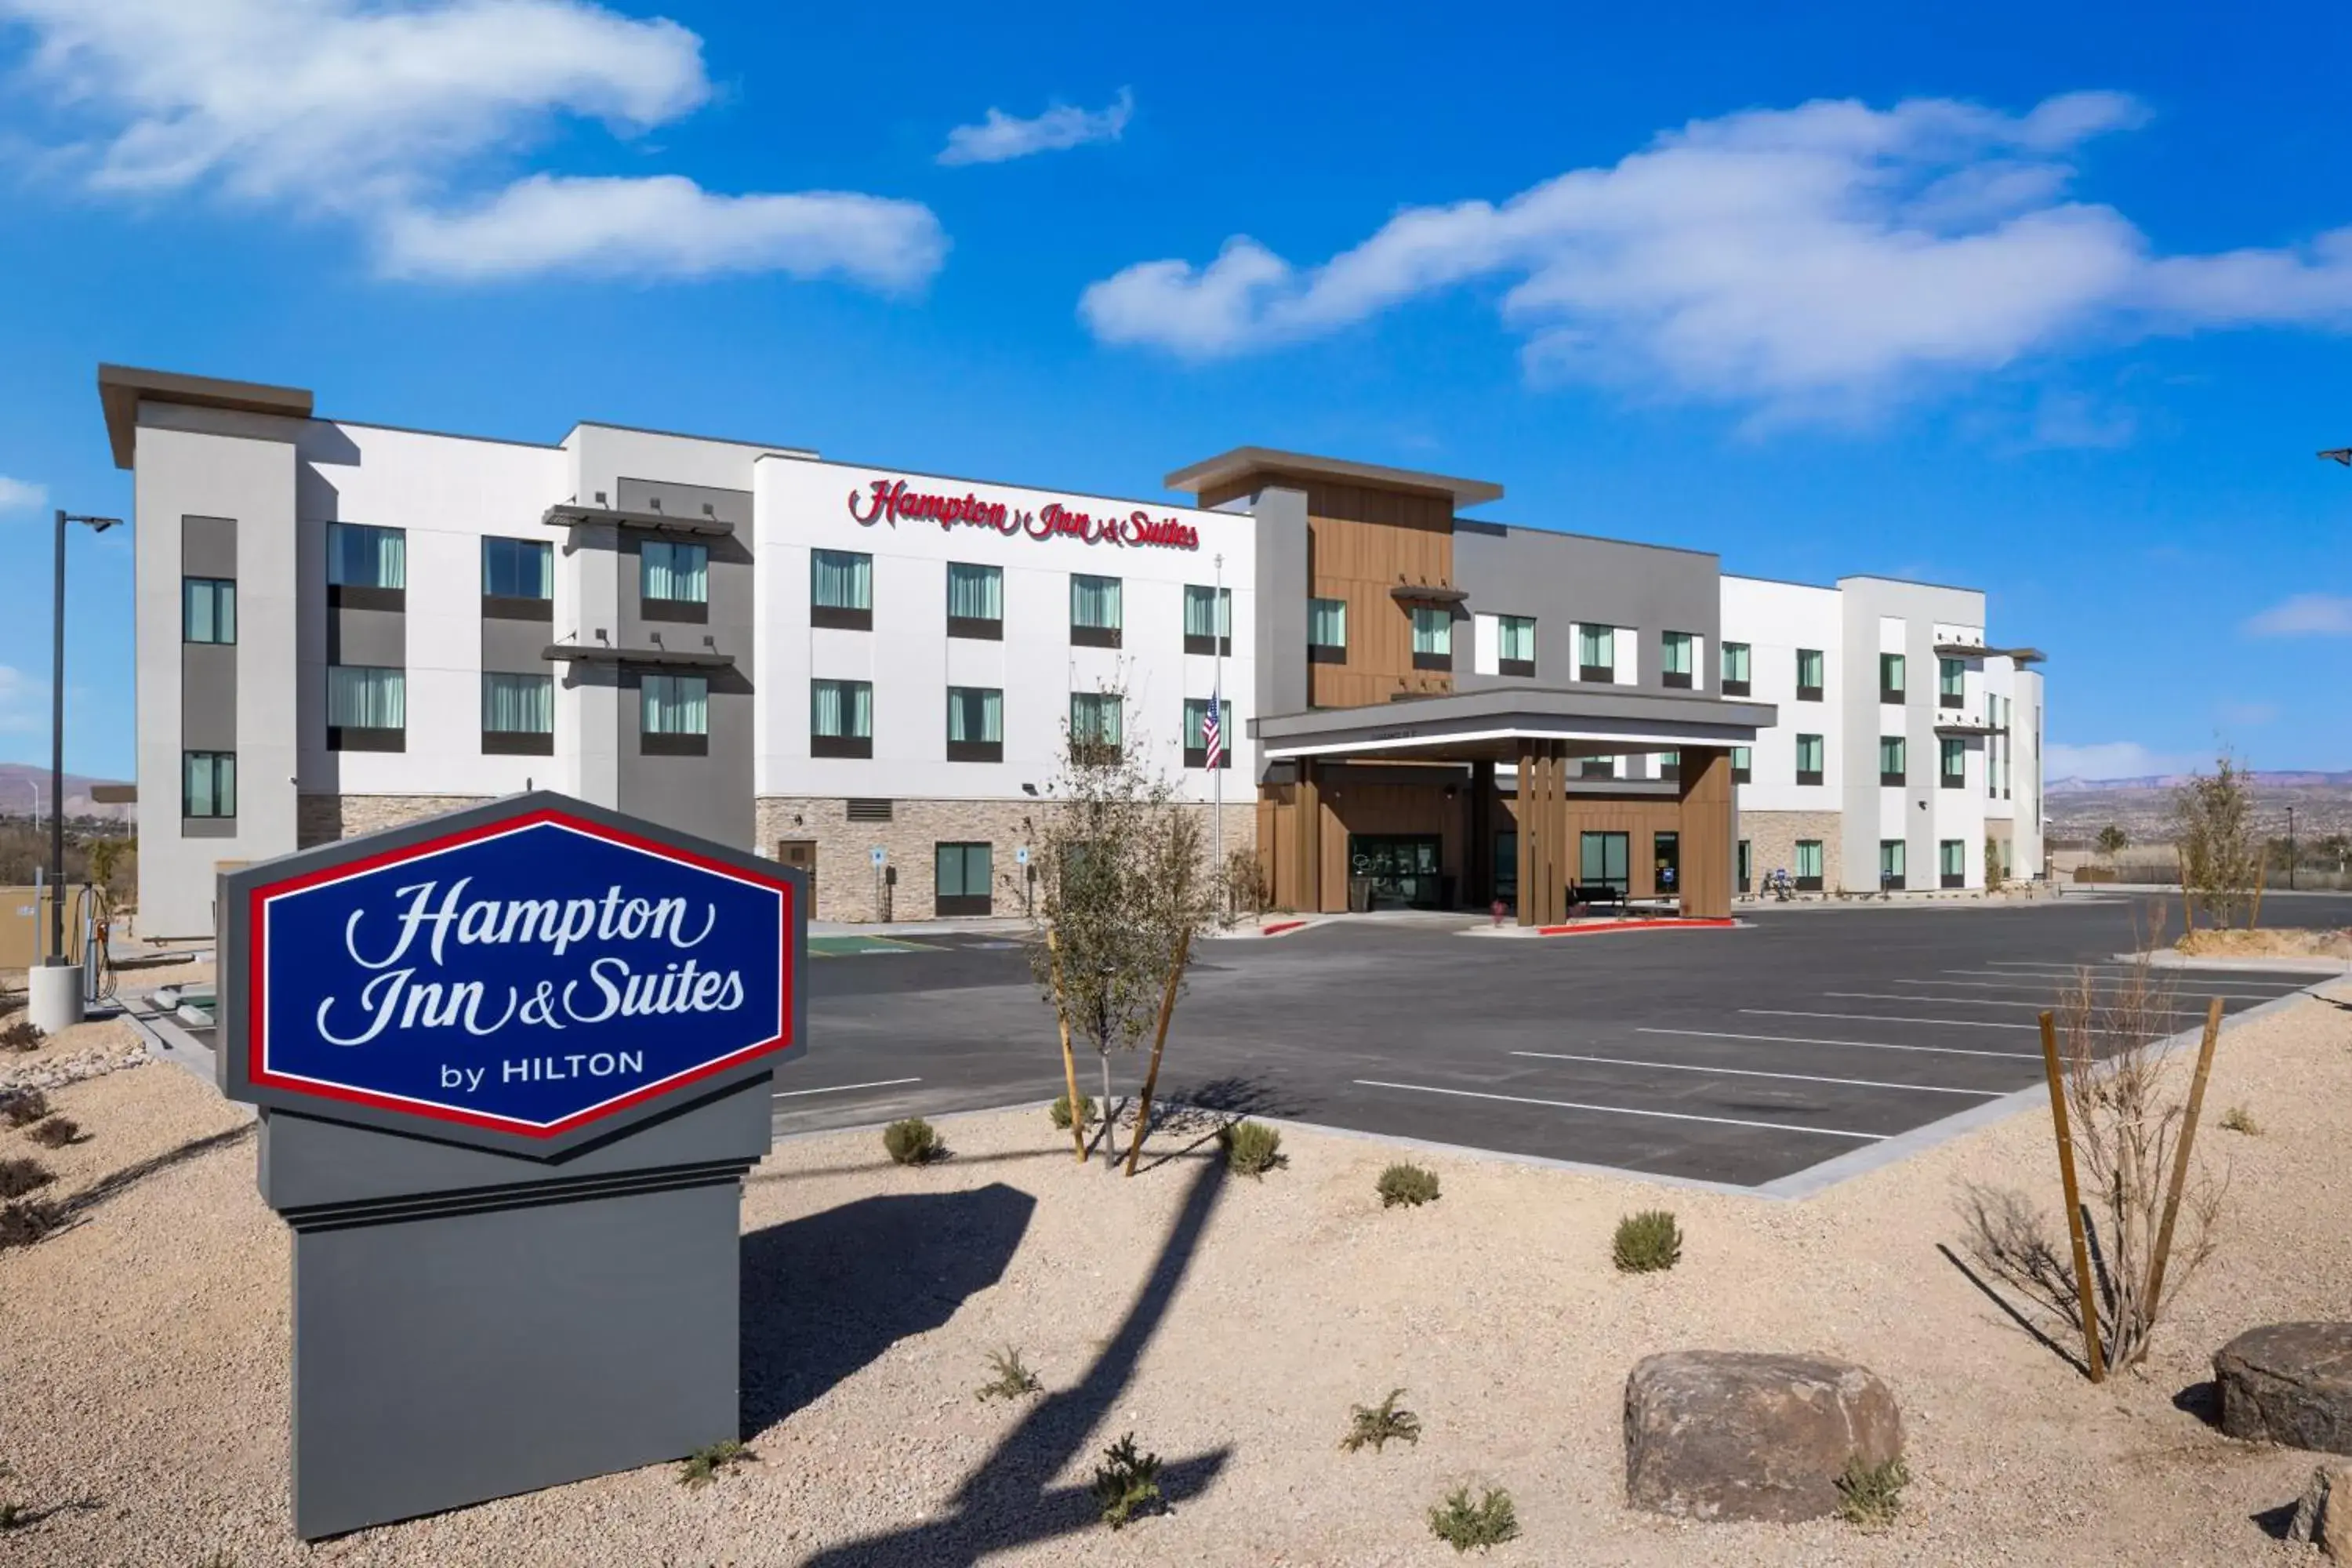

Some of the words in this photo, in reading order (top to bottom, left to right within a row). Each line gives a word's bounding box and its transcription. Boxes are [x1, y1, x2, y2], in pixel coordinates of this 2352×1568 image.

[848, 479, 1020, 535] Hampton
[1023, 503, 1102, 542] Inn
[1100, 517, 1123, 545] &
[1121, 511, 1199, 549] Suites
[347, 877, 717, 969] Hampton
[317, 967, 517, 1046] Inn
[521, 981, 566, 1029] &
[563, 957, 745, 1023] Suites
[441, 1064, 485, 1092] by
[503, 1051, 644, 1083] HILTON
